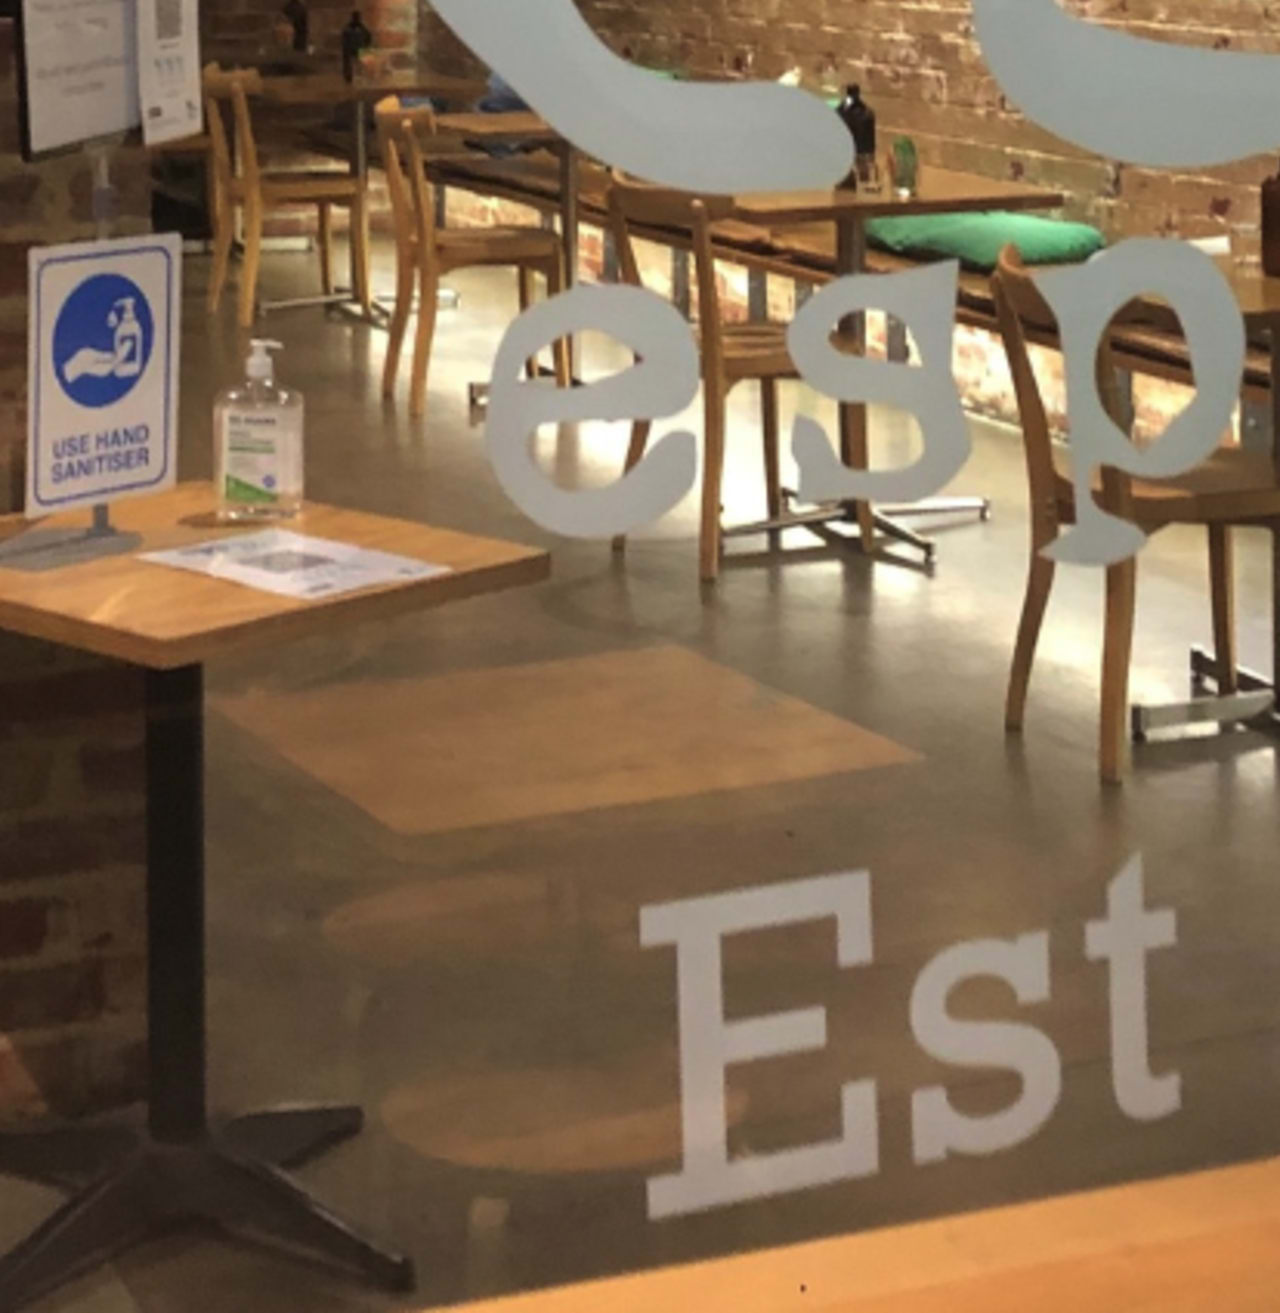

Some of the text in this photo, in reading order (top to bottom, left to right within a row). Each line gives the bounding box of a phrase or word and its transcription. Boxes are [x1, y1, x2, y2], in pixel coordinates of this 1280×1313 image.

[52, 423, 149, 459] USE HAND
[51, 447, 149, 484] SANITISER
[638, 853, 1185, 1218] Est
